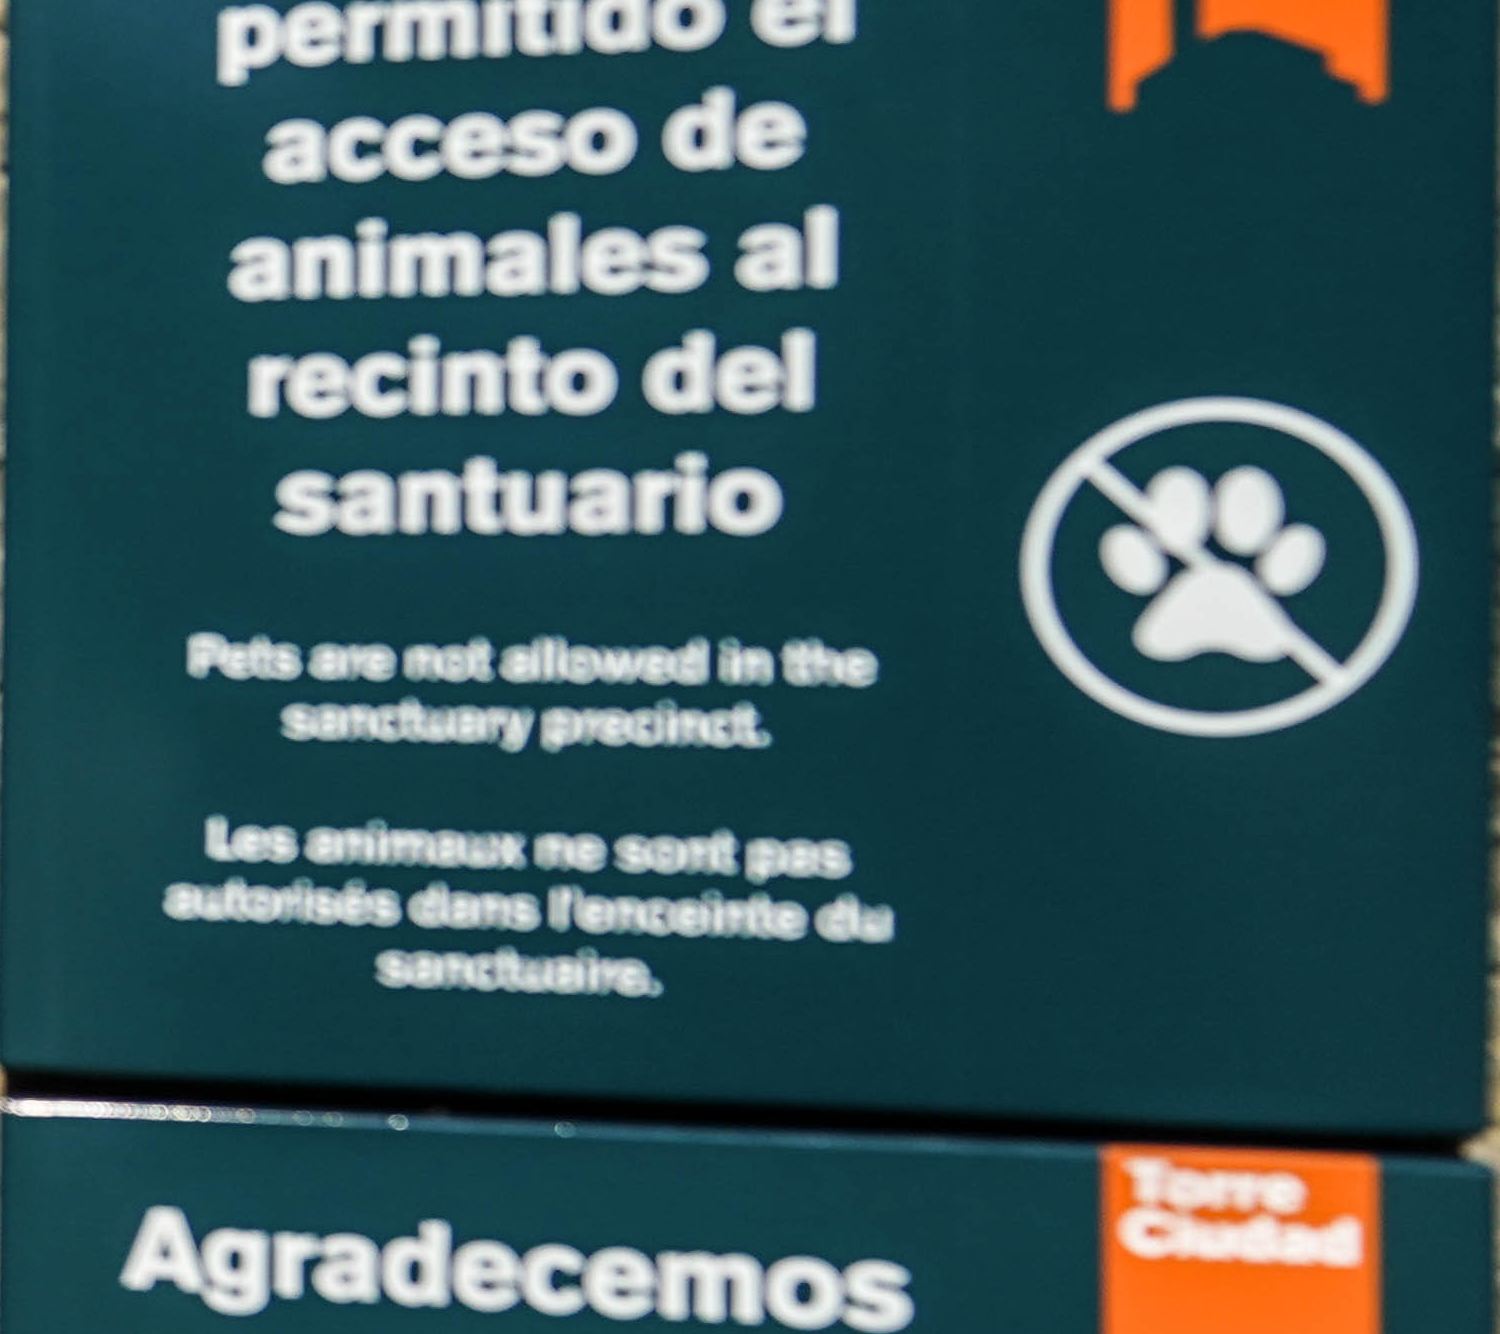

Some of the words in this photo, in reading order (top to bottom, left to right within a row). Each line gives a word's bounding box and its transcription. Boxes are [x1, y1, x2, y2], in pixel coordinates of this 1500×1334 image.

[262, 107, 638, 185] acceso
[661, 86, 807, 173] de
[226, 211, 710, 303] animales
[734, 204, 839, 292] al
[247, 334, 618, 420] recinto
[642, 327, 816, 415] del
[274, 451, 783, 537] santuario
[185, 630, 304, 682] Pets
[306, 642, 398, 683] are
[401, 637, 494, 684] not
[497, 633, 711, 687] allowed
[716, 637, 776, 685] in
[780, 638, 879, 689] the
[279, 696, 536, 753] sanctuary
[538, 699, 774, 752] precinct.
[203, 814, 300, 865] Les
[302, 819, 527, 870] animaux
[532, 832, 608, 874] ne
[612, 828, 738, 876] sont
[743, 837, 853, 883] pas
[161, 876, 403, 928] autorisés
[405, 880, 543, 933] dans
[546, 884, 809, 942] l'enceinte
[813, 892, 896, 944] du
[374, 946, 664, 998] sanctuaire.
[1121, 1155, 1308, 1216] Torre
[119, 1205, 914, 1333] Agradecemos
[1116, 1203, 1363, 1267] Ciudad
